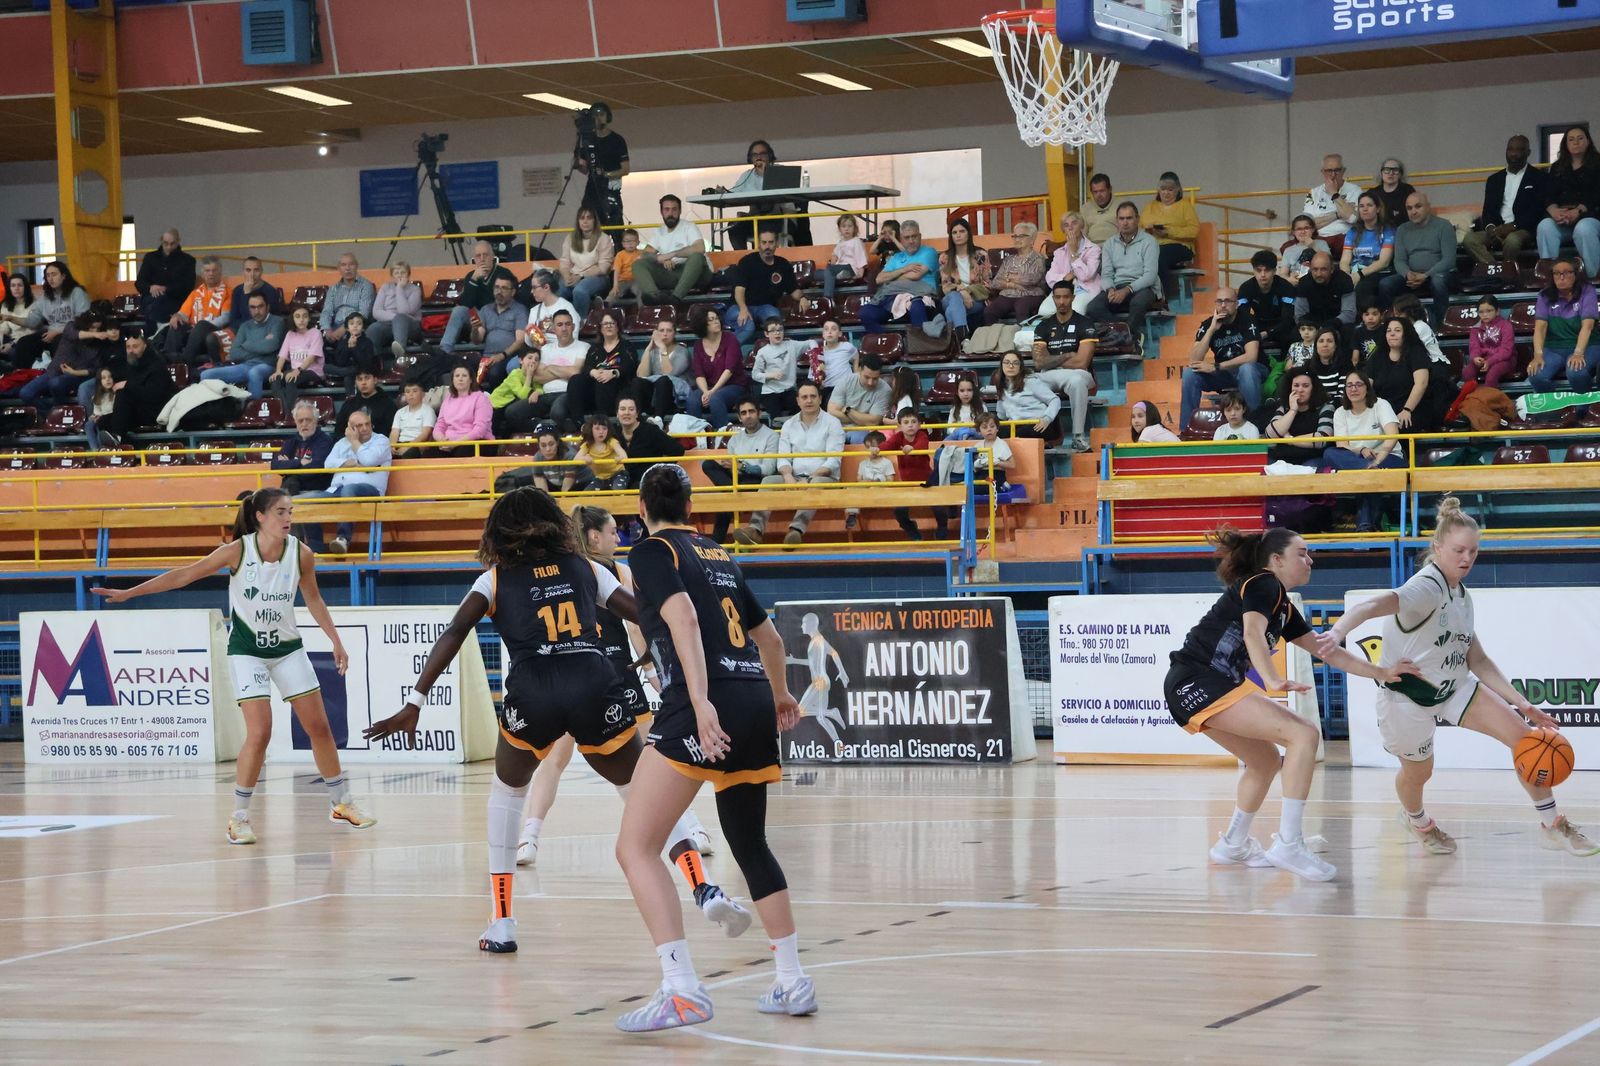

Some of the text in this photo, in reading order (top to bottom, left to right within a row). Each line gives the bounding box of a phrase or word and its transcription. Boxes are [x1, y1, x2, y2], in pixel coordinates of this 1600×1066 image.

[1333, 3, 1455, 34] Sports
[654, 308, 661, 318] 7
[877, 337, 888, 346] 17
[1513, 450, 1531, 461] 37
[1060, 509, 1099, 525] FIL
[533, 565, 560, 578] FILOR
[544, 588, 574, 599] ZAMORA
[255, 608, 282, 625] Mijas
[537, 601, 582, 641] 14
[721, 597, 746, 648] 8
[833, 608, 993, 631] TÉCNICA Y ORTOPEDIA
[383, 623, 452, 644] LUIS FELIP
[1059, 624, 1171, 635] E.S. CAMINO DE LA PLATA
[256, 629, 280, 648] 55
[1059, 638, 1129, 649] Tfno.: 980 570 021
[865, 639, 970, 677] ANTONIO
[1060, 653, 1156, 665] Morales del Vino (Zamora)
[847, 681, 993, 726] HERNÁNDEZ
[1061, 699, 1101, 710] SERVICIO
[1104, 699, 1111, 710] A
[1114, 699, 1161, 710] DOMICILIO
[31, 717, 61, 725] Avenida
[80, 717, 107, 725] Cruces
[110, 717, 118, 725] 17
[121, 717, 137, 725] Entr
[151, 717, 175, 725] 49008
[176, 716, 207, 725] Zamora
[1061, 714, 1089, 725] Gasóleo
[1090, 715, 1099, 724] de
[1100, 714, 1138, 725] Calefacción
[1140, 718, 1145, 726] y
[51, 730, 200, 740] marianandresasesoria@gmail.com
[50, 746, 70, 757] 980
[73, 746, 87, 757] 05
[89, 746, 103, 757] 85
[104, 746, 118, 757] 90
[127, 746, 147, 756] 605
[151, 746, 164, 756] 76
[167, 746, 180, 756] 71
[184, 745, 198, 756] 05
[789, 739, 1004, 761] Avda. Cardenal Cisneros, 21
